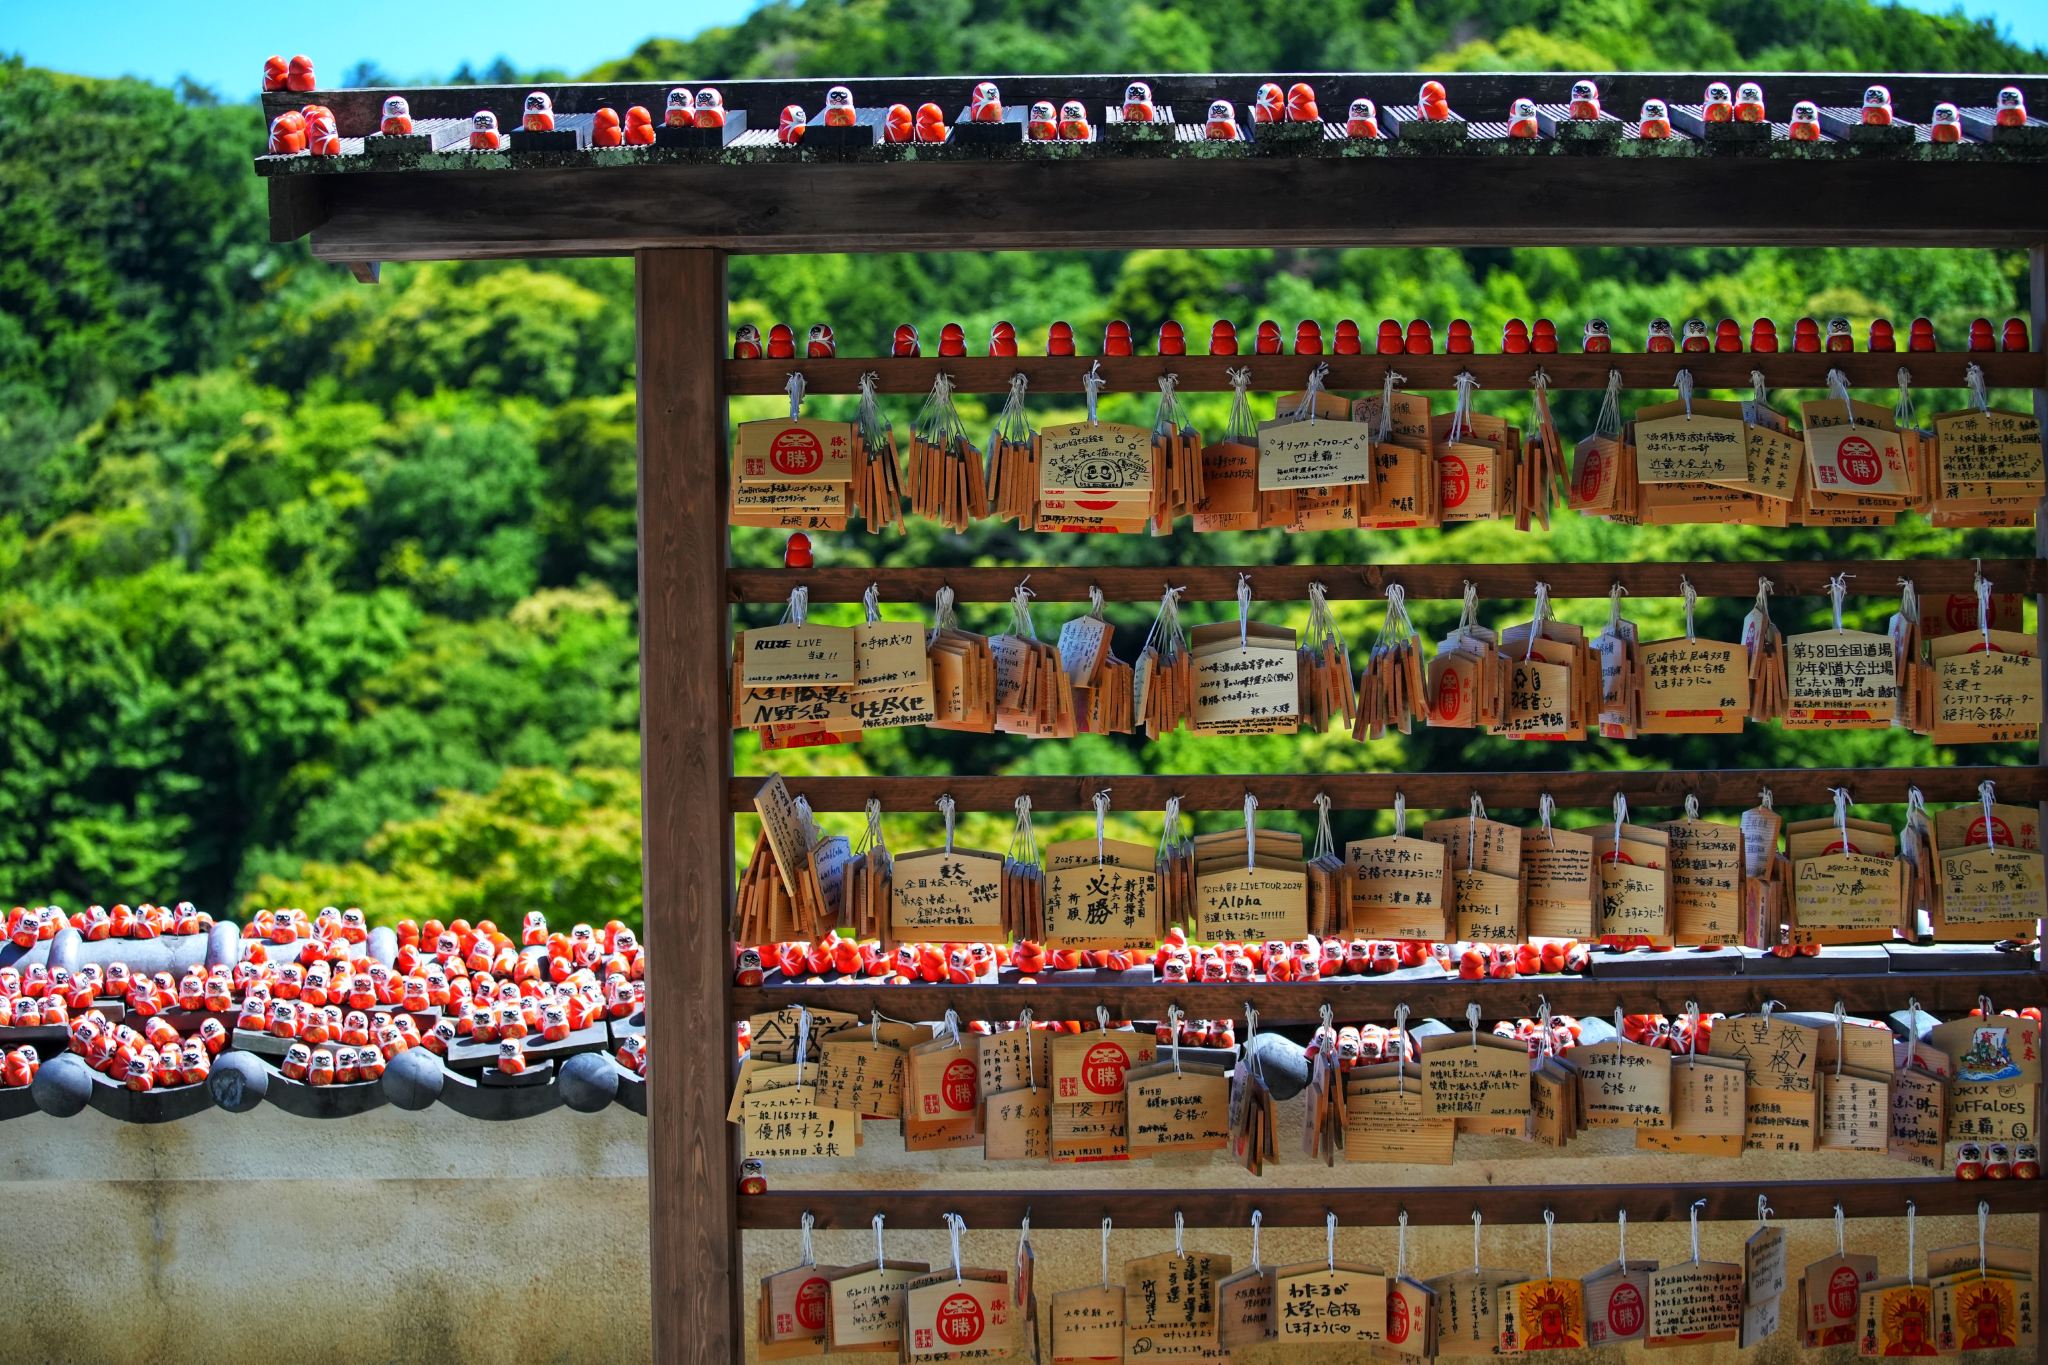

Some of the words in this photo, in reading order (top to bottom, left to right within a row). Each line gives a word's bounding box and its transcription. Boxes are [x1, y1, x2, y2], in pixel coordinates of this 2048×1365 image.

[830, 436, 843, 459] 勝札
[1277, 440, 1310, 451] オリックス
[787, 450, 807, 468] 勝
[1852, 459, 1870, 478] 勝
[1885, 447, 1898, 471] 勝札
[797, 638, 822, 648] LIVE
[1793, 642, 1893, 658] 第58回全国道場
[1645, 650, 1731, 665] 尼崎市立尼崎双星
[1650, 664, 1726, 677] 高等学校に合格
[1795, 661, 1894, 676] 少年剣道大会出場
[1654, 676, 1712, 690] しますように。
[1794, 677, 1832, 688] ぜったい
[1351, 846, 1423, 863] 第一志望校に
[1240, 882, 1258, 891] LIVE
[1261, 882, 1281, 890] TOUR
[1283, 882, 1303, 891] 2024
[1832, 879, 1866, 896] 必勝
[1066, 893, 1082, 921] 祈願
[1085, 874, 1114, 925] 必勝
[1123, 879, 1137, 929] 新体操部
[1208, 895, 1262, 909] +Alpha
[1724, 1021, 1805, 1053] 志望校
[888, 1056, 903, 1095] 自分に
[1097, 1067, 1118, 1087] 勝
[870, 1079, 884, 1113] 勝つ!
[955, 1083, 971, 1104] 勝
[755, 1119, 835, 1141] 優勝する!
[1288, 1283, 1350, 1299] わたるが
[990, 1300, 1003, 1325] 勝札
[1284, 1300, 1361, 1319] 大学に合格
[1619, 1307, 1634, 1329] 勝
[951, 1319, 971, 1338] 勝
[1285, 1321, 1340, 1336] しますように
[1356, 1331, 1381, 1341] さちこ
[1504, 1311, 1515, 1347] 勝尾寺
